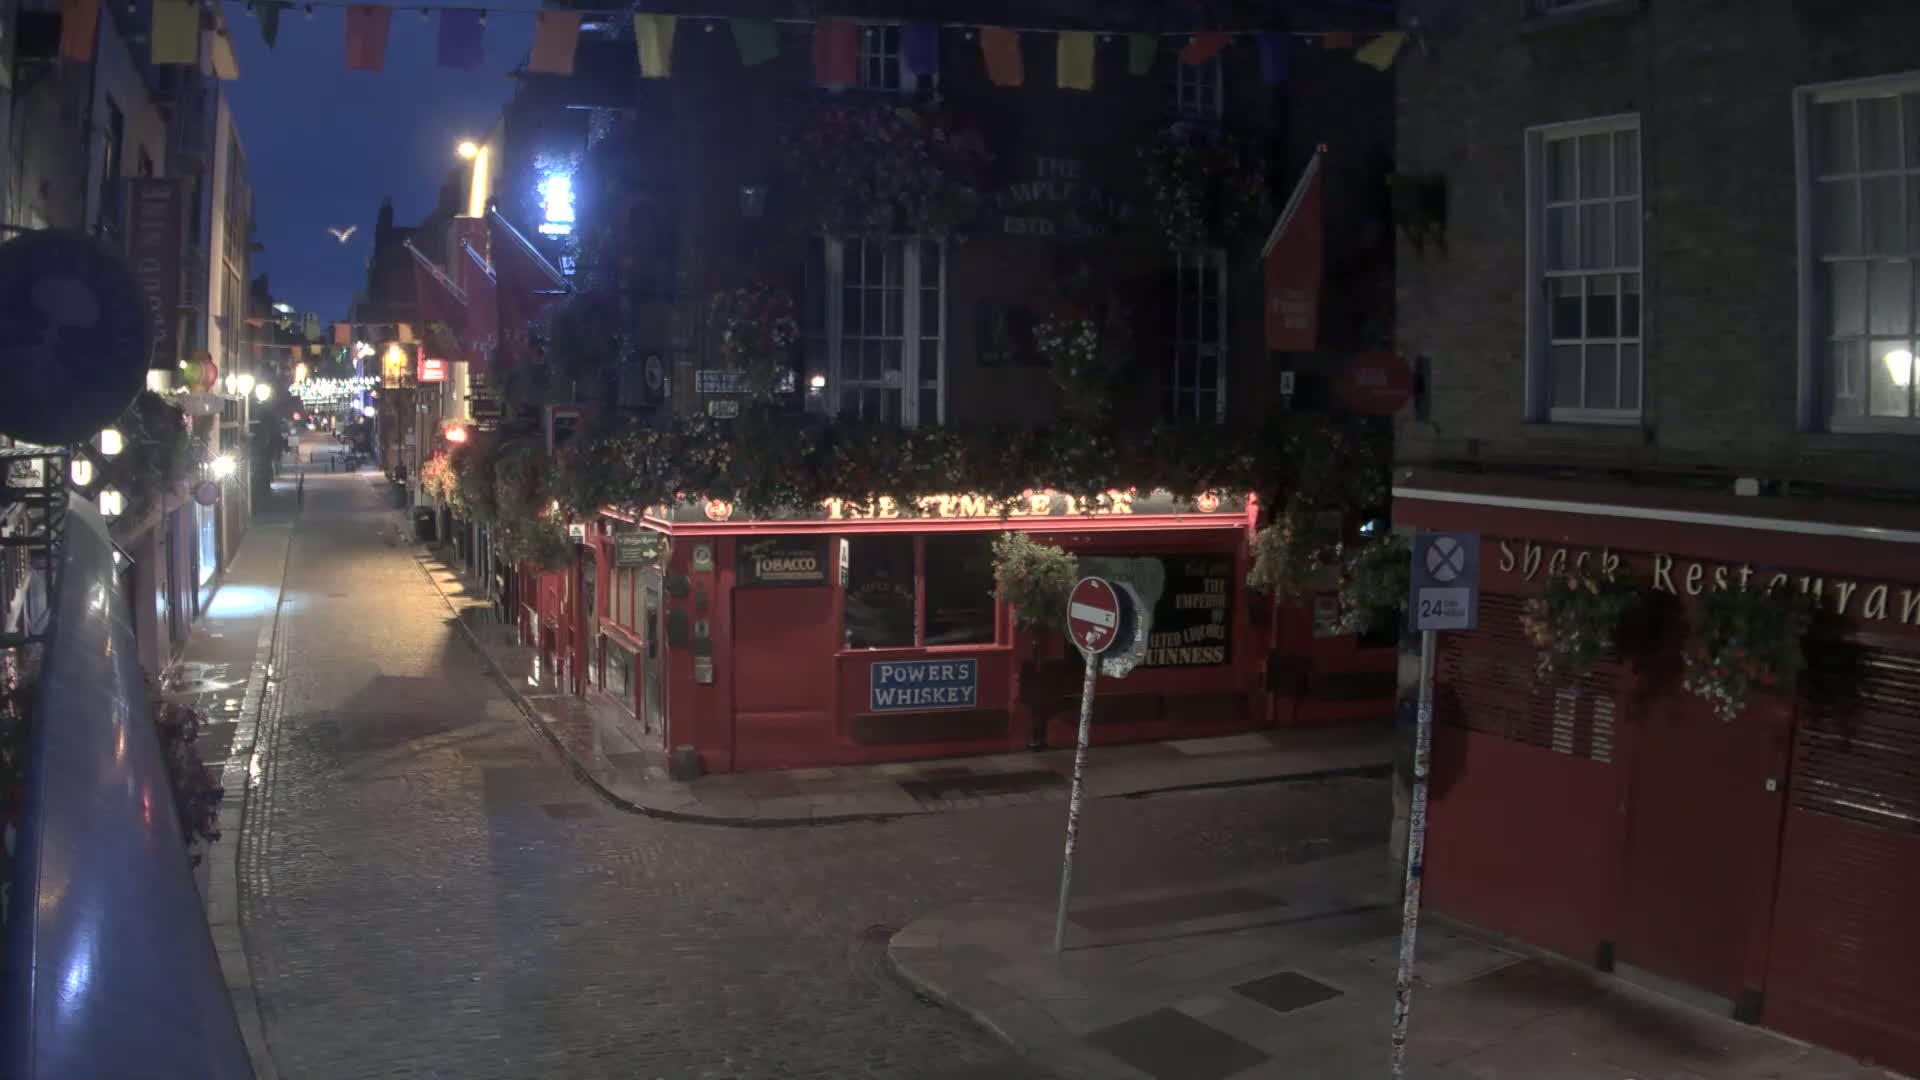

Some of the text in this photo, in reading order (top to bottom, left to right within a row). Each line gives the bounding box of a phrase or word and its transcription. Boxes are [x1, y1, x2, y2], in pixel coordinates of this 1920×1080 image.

[755, 554, 816, 576] TOBACCO
[1421, 599, 1442, 618] 24
[1145, 646, 1225, 666] UINNESS
[880, 663, 968, 683] POWER'S
[874, 686, 974, 705] WHISKEY
